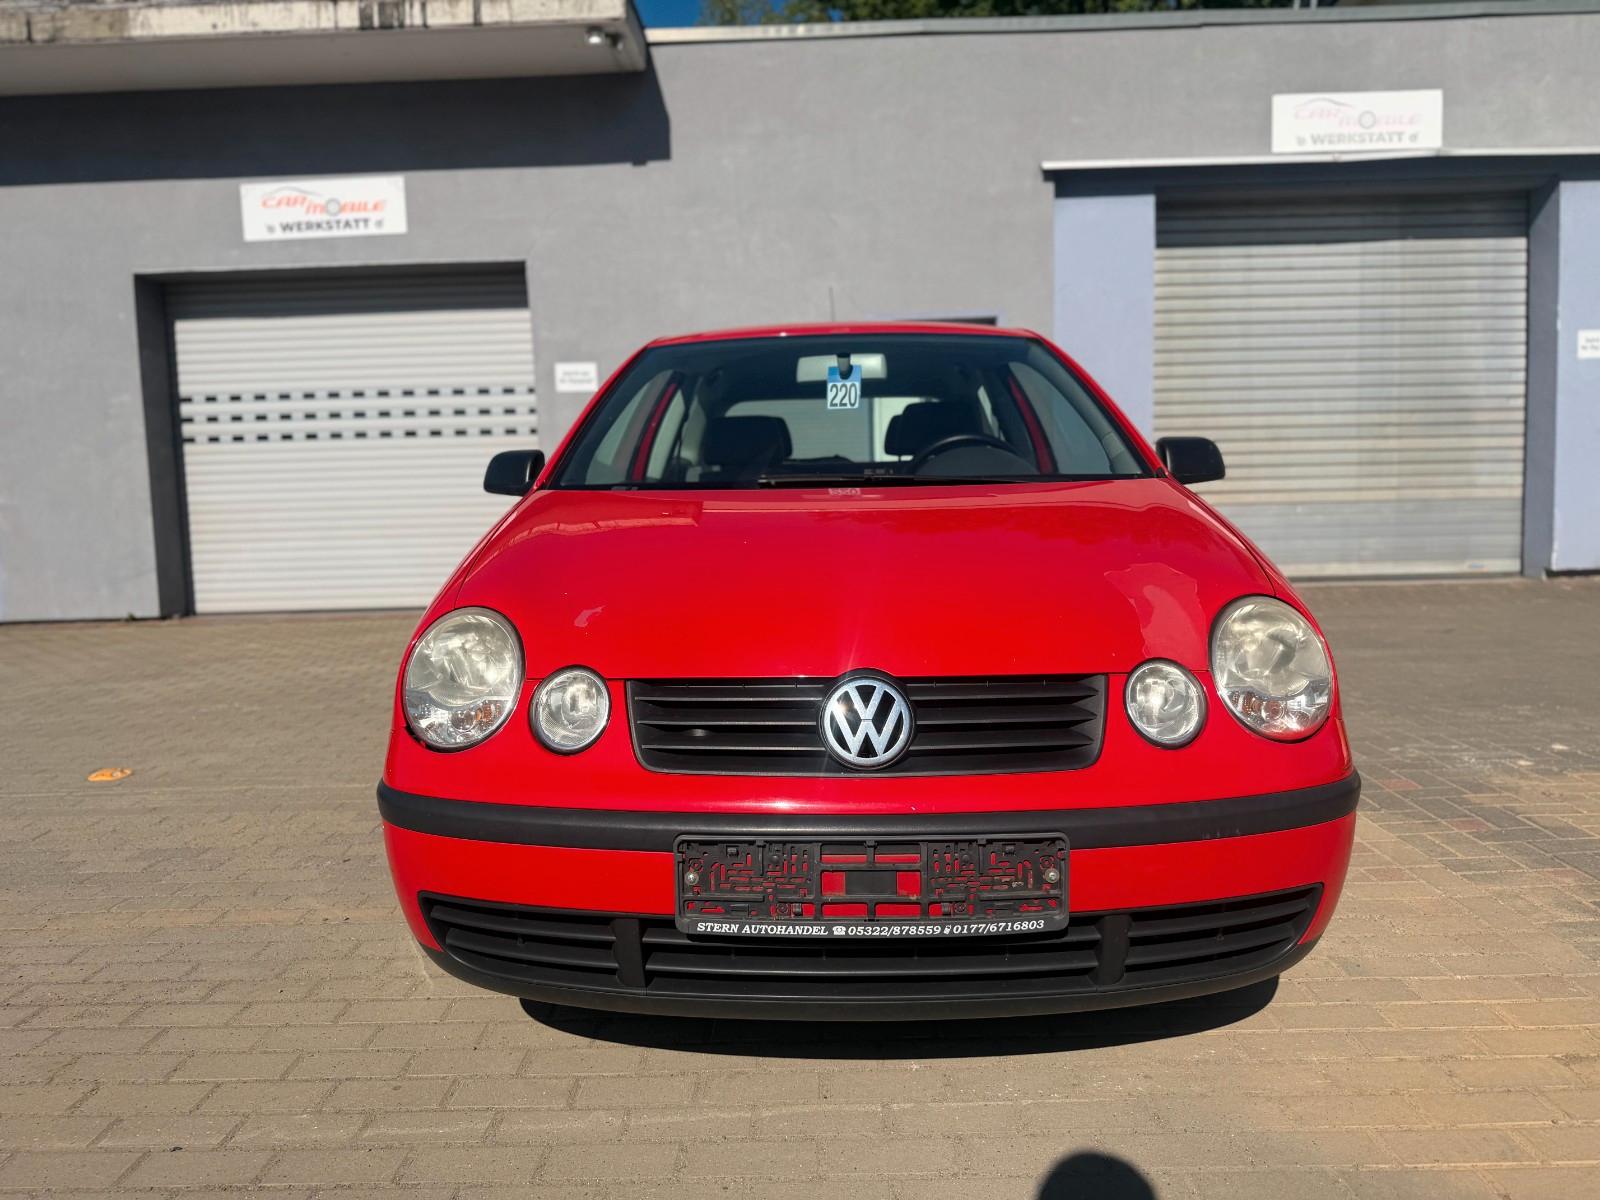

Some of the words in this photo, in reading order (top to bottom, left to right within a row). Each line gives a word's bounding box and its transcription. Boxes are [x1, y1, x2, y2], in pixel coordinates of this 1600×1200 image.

[1310, 131, 1405, 146] WERKSTATT
[279, 217, 371, 233] WERKSTATT
[829, 383, 858, 407] 220
[697, 922, 739, 934] STERN
[742, 924, 829, 936] AUTOHANDEL
[847, 925, 942, 937] 05322/878559
[953, 920, 1045, 934] 0177/6716803
